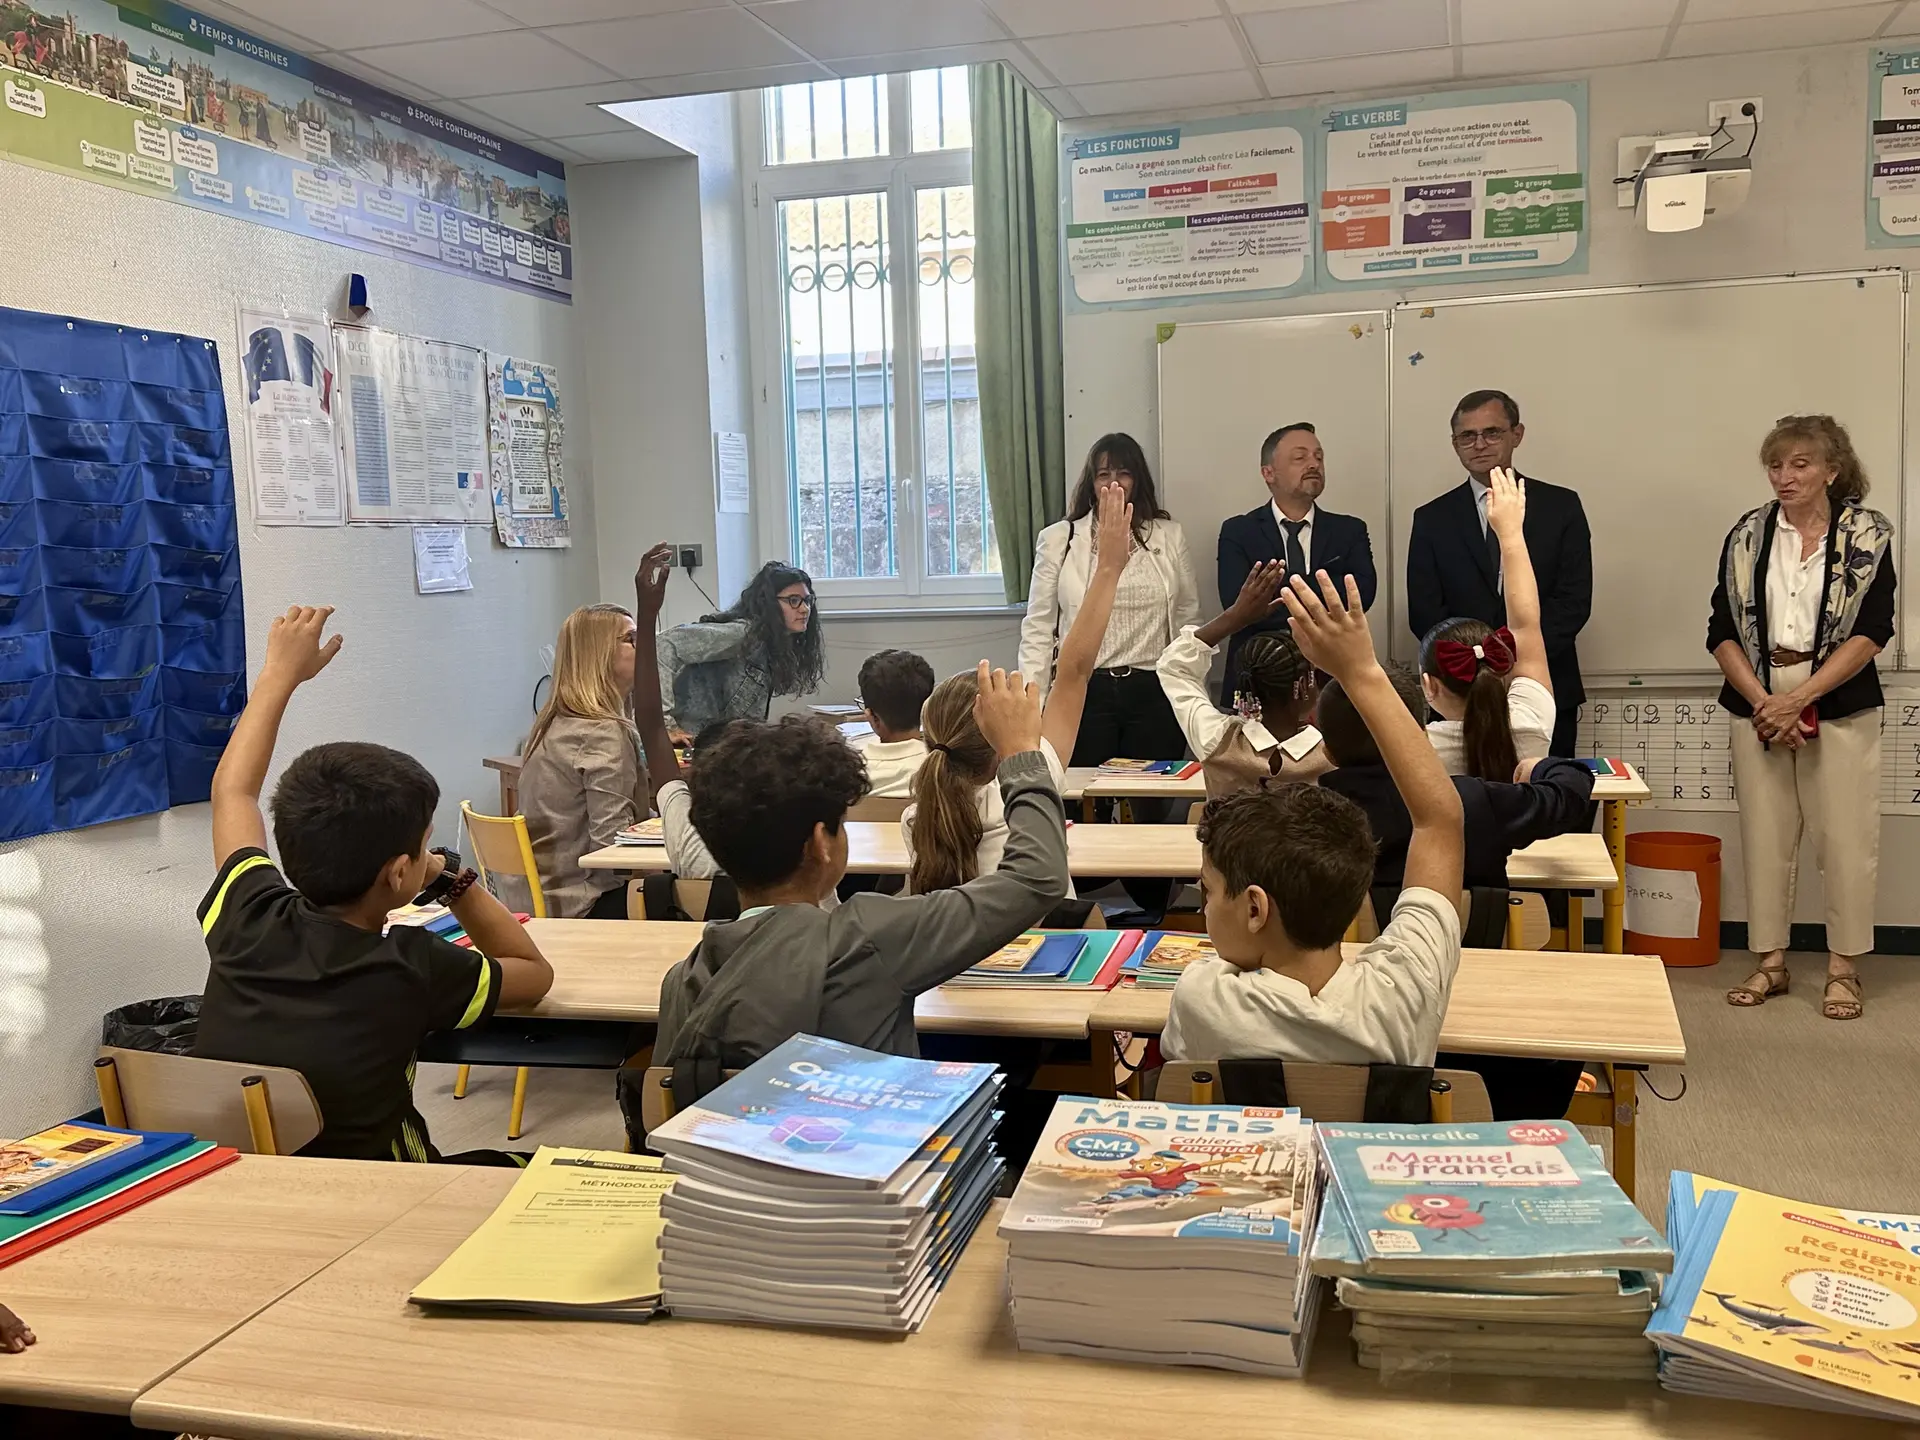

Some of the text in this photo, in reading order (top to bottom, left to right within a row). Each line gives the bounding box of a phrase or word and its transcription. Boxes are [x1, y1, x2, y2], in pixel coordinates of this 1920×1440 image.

[151, 22, 185, 42] RENAISSANCE
[200, 23, 288, 68] TEMPS MODERNES
[136, 70, 166, 86] Découverte
[131, 84, 160, 100] Christophe
[1344, 110, 1400, 126] LE VERBE
[414, 108, 444, 128] ÉPOQUE
[445, 121, 502, 151] CONTEMPORAINE
[1370, 132, 1387, 140] C'est
[1396, 130, 1410, 138] mot
[1412, 130, 1422, 138] qui
[1424, 126, 1450, 136] indique
[1468, 122, 1490, 130] action
[1423, 135, 1444, 144] forme
[1460, 130, 1498, 140] conjuguée
[1088, 135, 1173, 154] LES FONCTIONS
[1367, 150, 1388, 158] verbe
[1389, 148, 1400, 156] est
[1440, 142, 1466, 150] radical
[1467, 140, 1475, 148] et
[1079, 166, 1088, 174] Ce
[1116, 162, 1134, 171] Célia
[1142, 158, 1164, 170] gagné
[1182, 154, 1206, 164] match
[1208, 152, 1234, 162] contre
[1235, 149, 1248, 158] Léa
[1418, 156, 1482, 168] Exemple chanter
[1138, 170, 1152, 178] Son
[1198, 163, 1215, 172] était
[1880, 166, 1888, 174] le
[1172, 186, 1192, 194] verbe
[1228, 178, 1260, 188] l'attribut
[1514, 180, 1552, 188] 3e groupe
[1120, 190, 1138, 200] sujet
[1337, 194, 1375, 203] 1er groupe
[1418, 188, 1456, 196] 2e groupe
[1192, 208, 1304, 224] les compléments circonstanciels
[1892, 214, 1918, 224] Quand
[1096, 224, 1140, 234] compléments
[1142, 220, 1166, 229] d'objet
[1126, 275, 1152, 284] fonction
[1153, 274, 1166, 282] d'un
[1208, 270, 1230, 278] groupe
[1242, 266, 1259, 274] mots
[1175, 280, 1198, 288] occupe
[1199, 278, 1214, 286] dans
[1675, 704, 1696, 724] R
[1674, 786, 1683, 798] R
[1701, 786, 1711, 800] S
[788, 1060, 944, 1099] Outils pour
[768, 1077, 926, 1111] les Maths
[1074, 1108, 1275, 1134] Maths
[1330, 1128, 1480, 1141] Bescherelle
[1510, 1128, 1562, 1139] CM1
[1074, 1138, 1134, 1153] CM1
[1179, 1145, 1258, 1154] manuel
[1077, 1150, 1114, 1159] Cycle
[1386, 1151, 1513, 1164] Manuel
[1372, 1161, 1564, 1178] de français
[1790, 1215, 1893, 1246] Méthode explicite
[1858, 1218, 1920, 1232] CM1
[1801, 1236, 1920, 1272] Rédiger
[1784, 1246, 1920, 1286] des écrit
[1836, 1286, 1884, 1302] Planifier
[1838, 1280, 1891, 1297] Observer
[1832, 1300, 1876, 1316] Réviser
[1830, 1308, 1890, 1327] Améliorer
